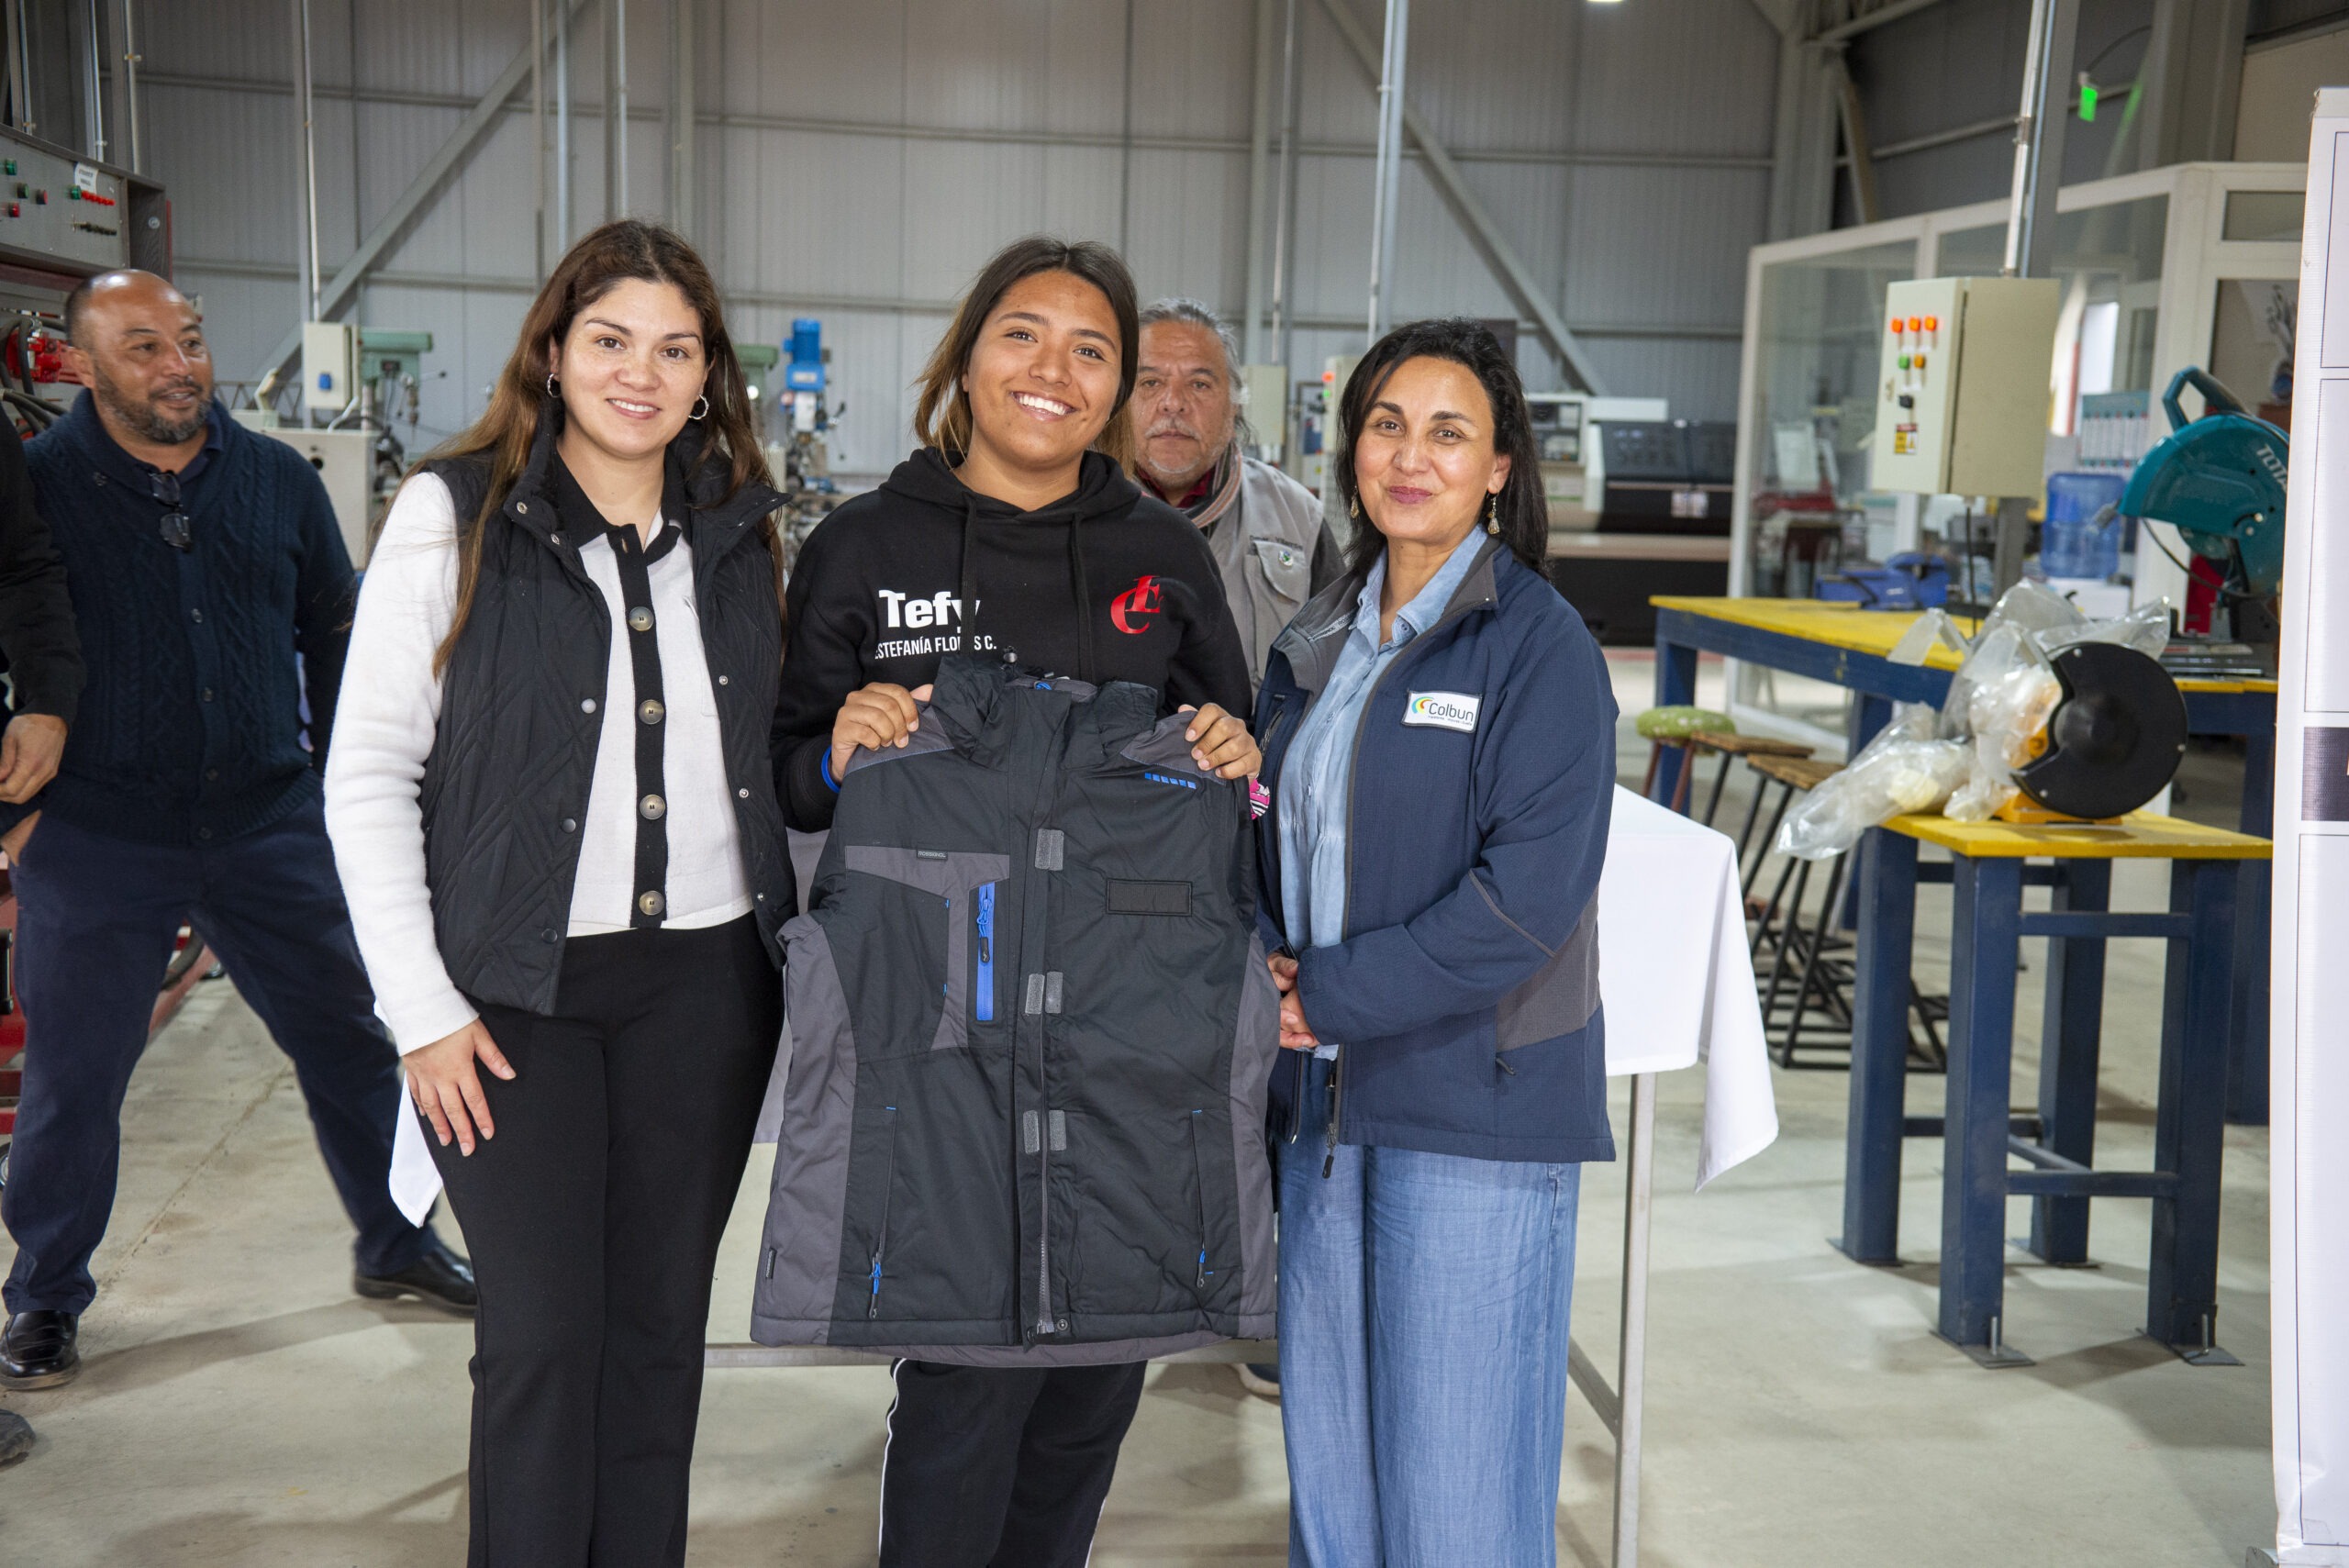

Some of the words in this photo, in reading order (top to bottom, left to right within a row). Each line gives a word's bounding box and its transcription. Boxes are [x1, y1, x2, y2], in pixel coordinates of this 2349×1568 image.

[874, 636, 932, 660] STEFANÍA
[934, 635, 982, 652] FLOS
[984, 635, 997, 651] C.
